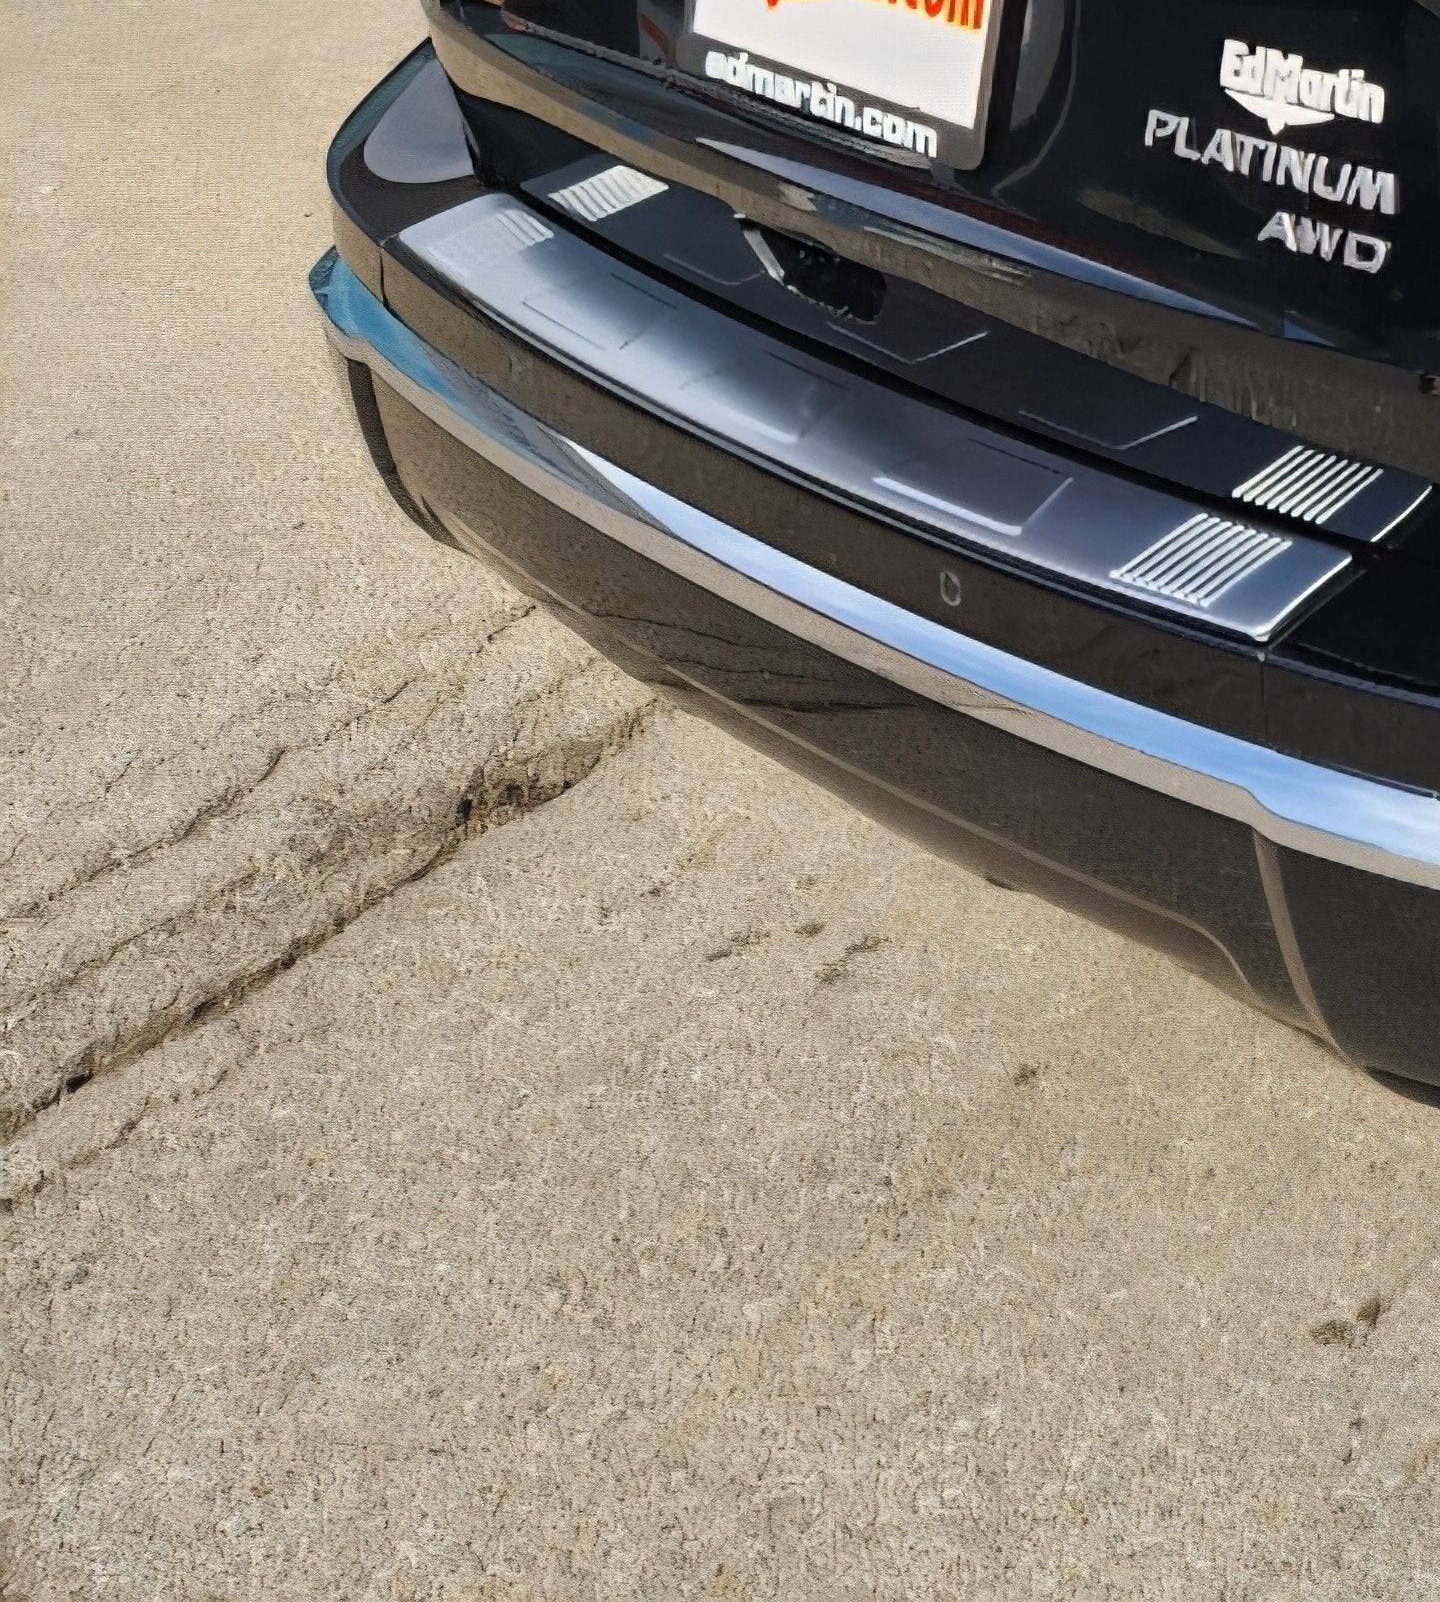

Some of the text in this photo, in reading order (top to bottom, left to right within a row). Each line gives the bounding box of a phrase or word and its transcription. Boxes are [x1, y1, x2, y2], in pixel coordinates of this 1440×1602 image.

[705, 50, 938, 158] edmartin.com
[1220, 38, 1386, 124] EdMartin
[1144, 108, 1399, 215] PLATINUM
[1256, 211, 1392, 275] AWD
